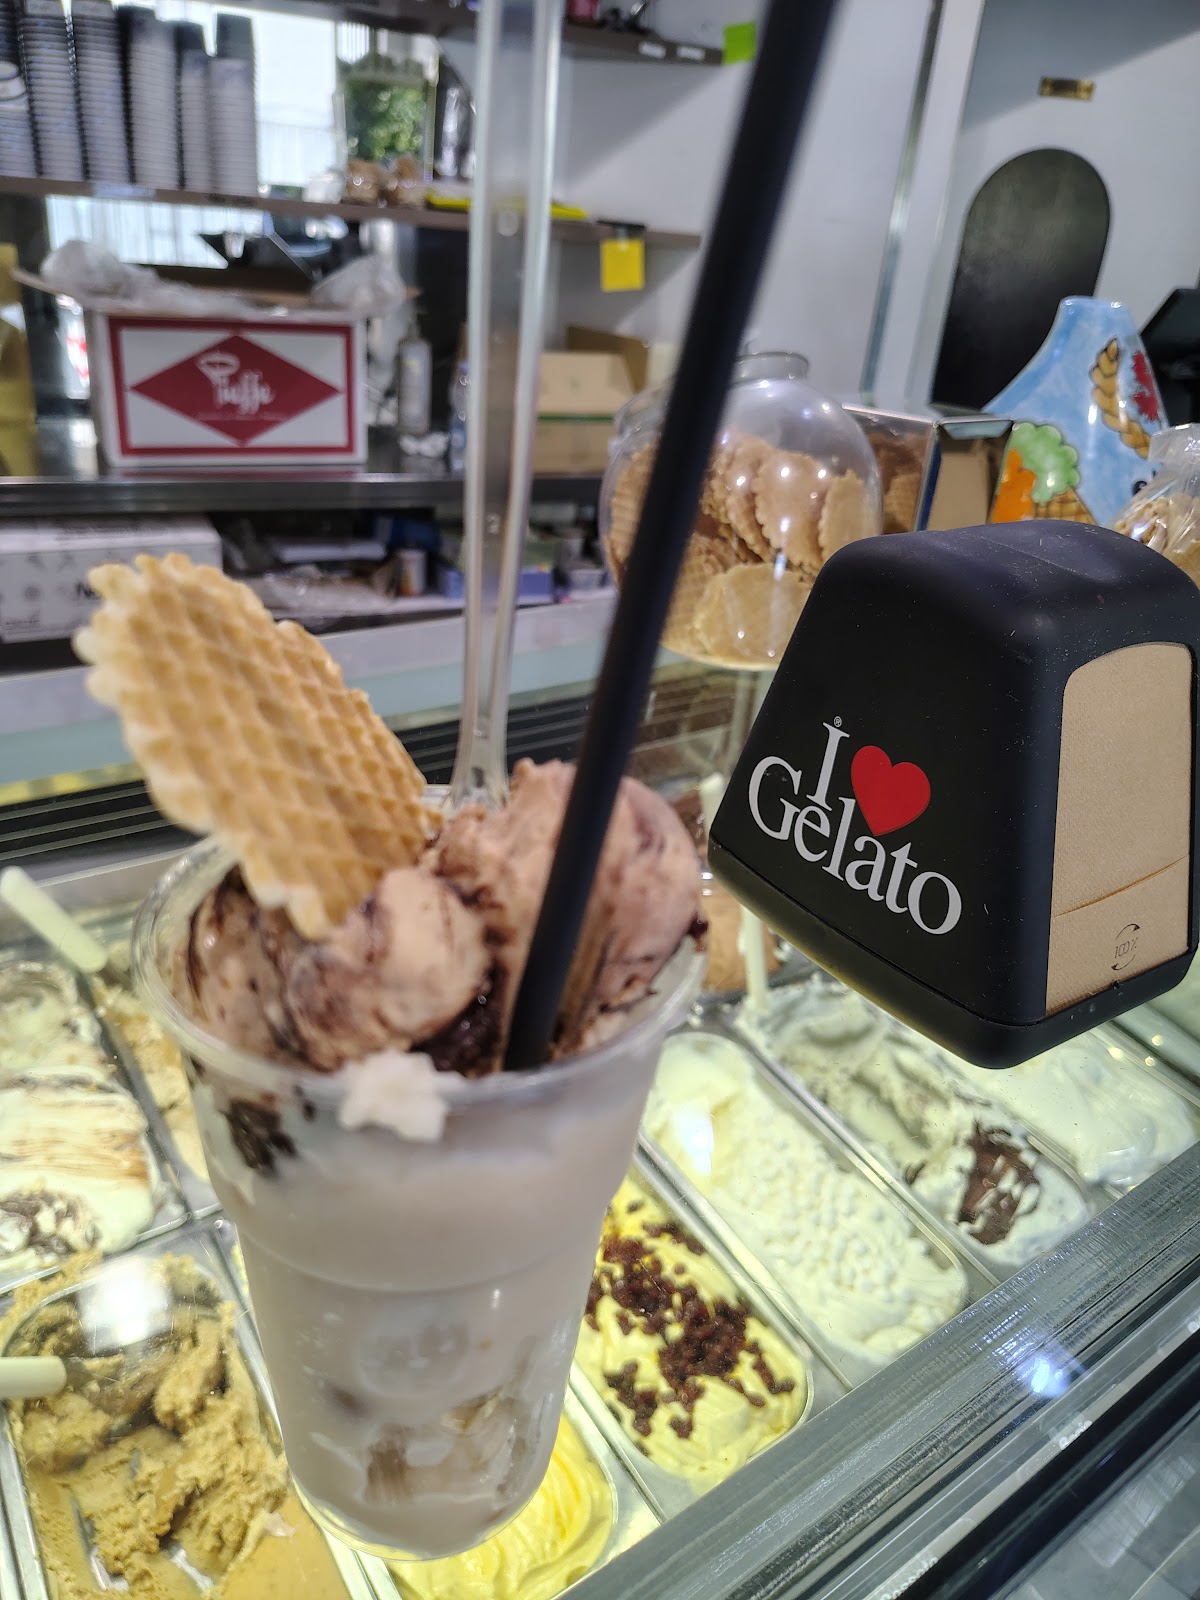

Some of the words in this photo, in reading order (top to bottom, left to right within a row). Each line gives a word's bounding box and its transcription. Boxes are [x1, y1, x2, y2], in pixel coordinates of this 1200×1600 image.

[806, 721, 850, 811] I
[749, 756, 962, 934] Gelato
[1114, 936, 1139, 959] 100%
